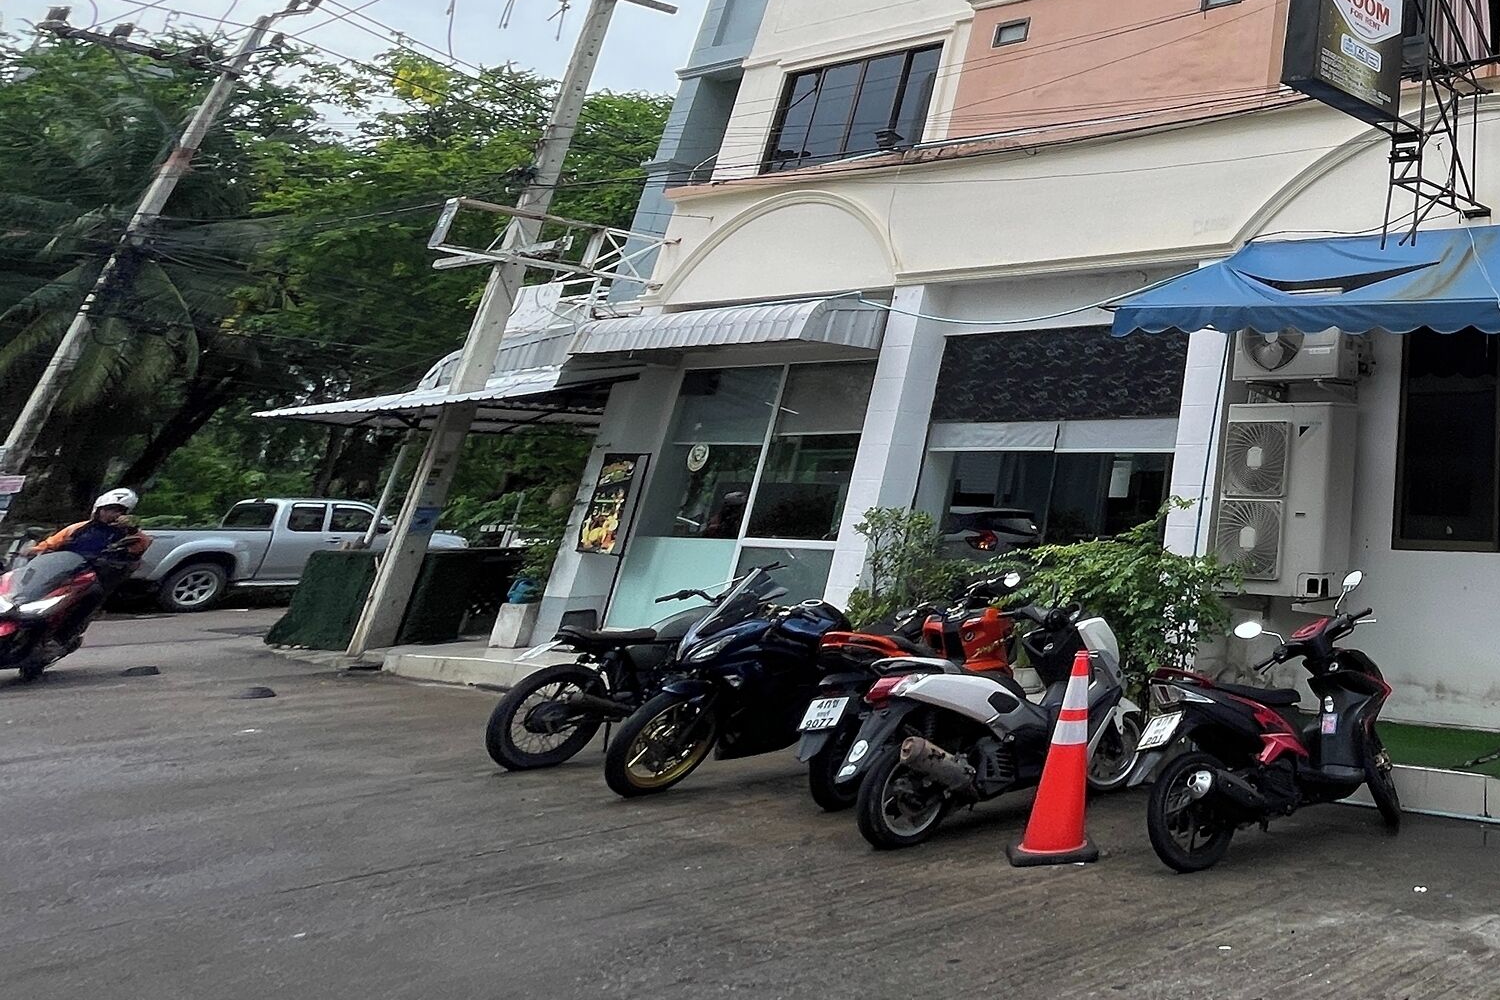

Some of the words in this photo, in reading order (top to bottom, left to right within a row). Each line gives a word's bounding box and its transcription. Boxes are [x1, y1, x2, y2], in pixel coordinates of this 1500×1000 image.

[1350, 7, 1364, 21] FOR
[1365, 17, 1381, 31] RENT
[805, 718, 834, 728] 9077
